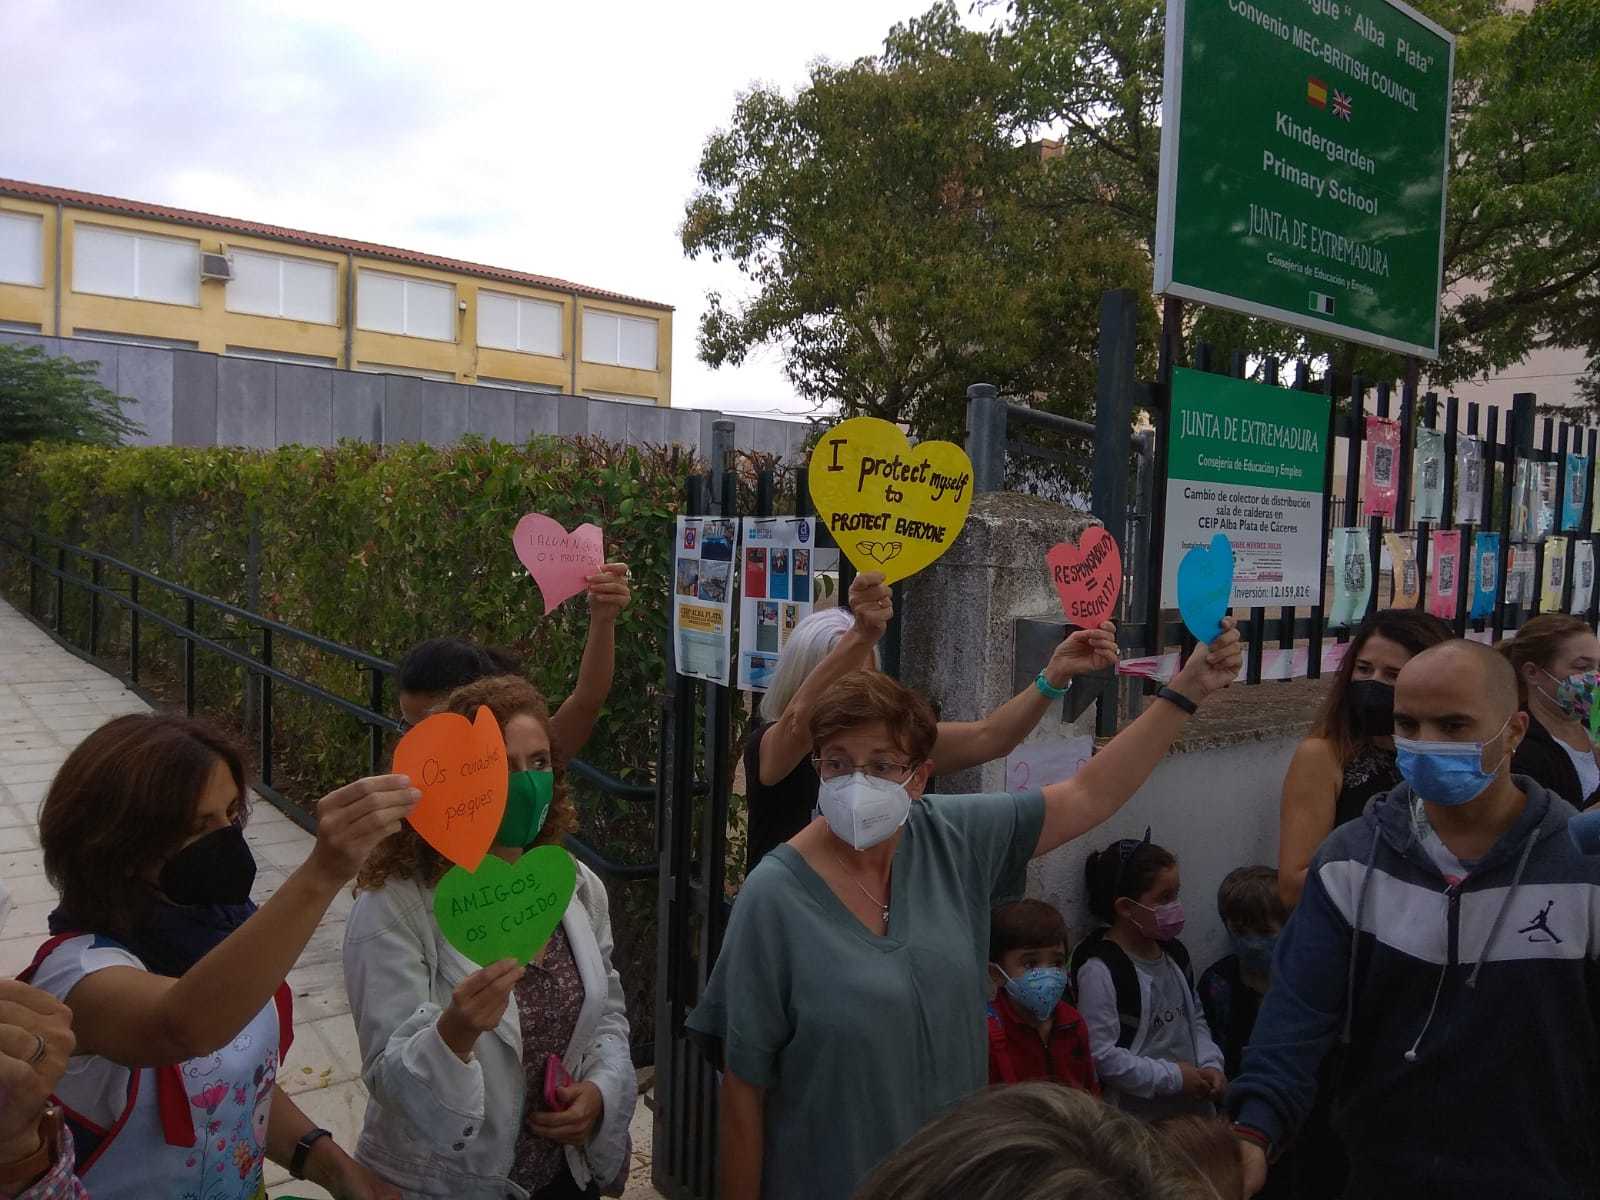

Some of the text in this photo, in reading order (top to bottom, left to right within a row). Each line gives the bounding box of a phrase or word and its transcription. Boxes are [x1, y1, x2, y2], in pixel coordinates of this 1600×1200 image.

[1229, 0, 1418, 112] Convenio MEC-BRITISH COUNCIL
[1276, 111, 1375, 175] Kindergarden
[1263, 150, 1378, 216] Primary School
[1249, 204, 1390, 278] JUNTA DE EXTREMADURA
[1180, 409, 1319, 453] JUNTA DE EXTREMADURA
[828, 439, 969, 503] I protect myself
[1234, 459, 1242, 471] de
[885, 485, 903, 503] to
[1184, 487, 1311, 509] Cambio de colector de distribución
[1216, 505, 1284, 520] sala de calderas en
[831, 513, 946, 543] PROTECT EVERYONE
[1198, 517, 1298, 533] CEIP Alba Plata de Cáceres
[1071, 572, 1115, 618] SECURITY
[1234, 585, 1311, 599] Inversión: 12.159,82€
[422, 757, 448, 786] Os
[445, 789, 494, 830] peques
[501, 892, 557, 932] CUIDO
